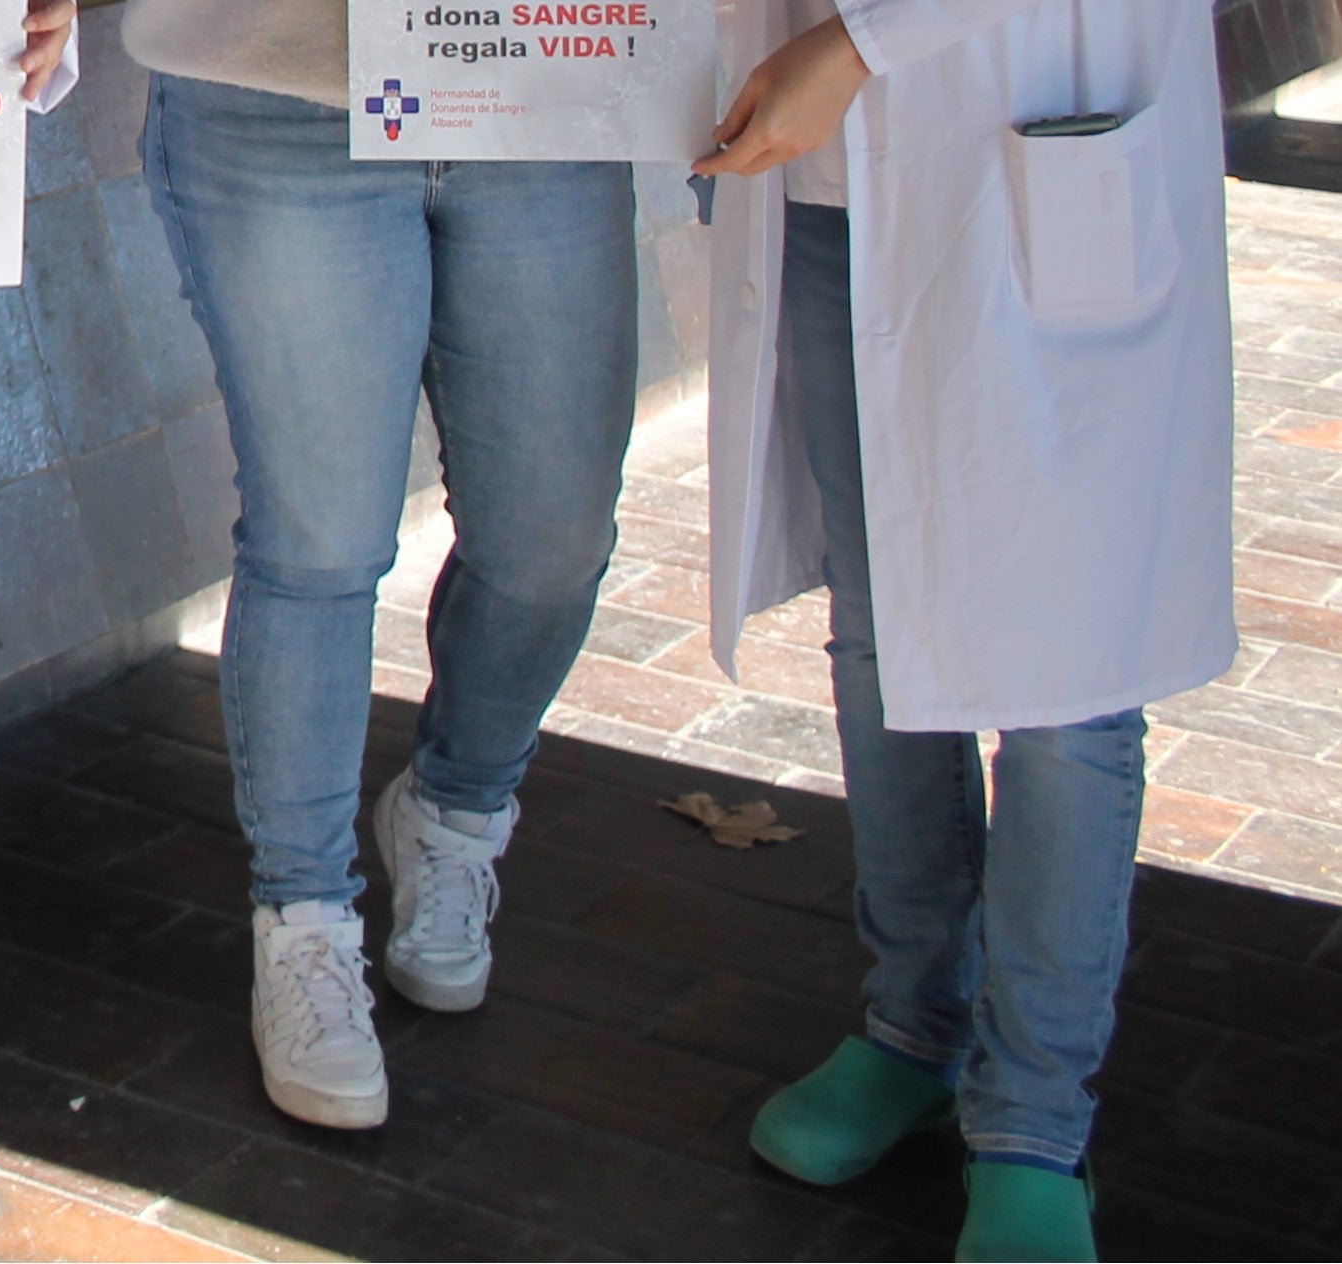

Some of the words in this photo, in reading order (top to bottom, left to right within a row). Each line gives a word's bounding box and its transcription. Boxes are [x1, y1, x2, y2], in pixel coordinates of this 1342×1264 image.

[425, 6, 500, 26] dona
[512, 4, 656, 30] SANGRE,
[428, 37, 526, 62] regala
[538, 36, 616, 57] VIDA
[430, 89, 486, 99] Hermandad
[488, 89, 500, 98] de
[430, 103, 475, 113] Donantes
[478, 103, 490, 113] de
[492, 103, 526, 115] Sangre
[430, 117, 473, 128] Albacete
